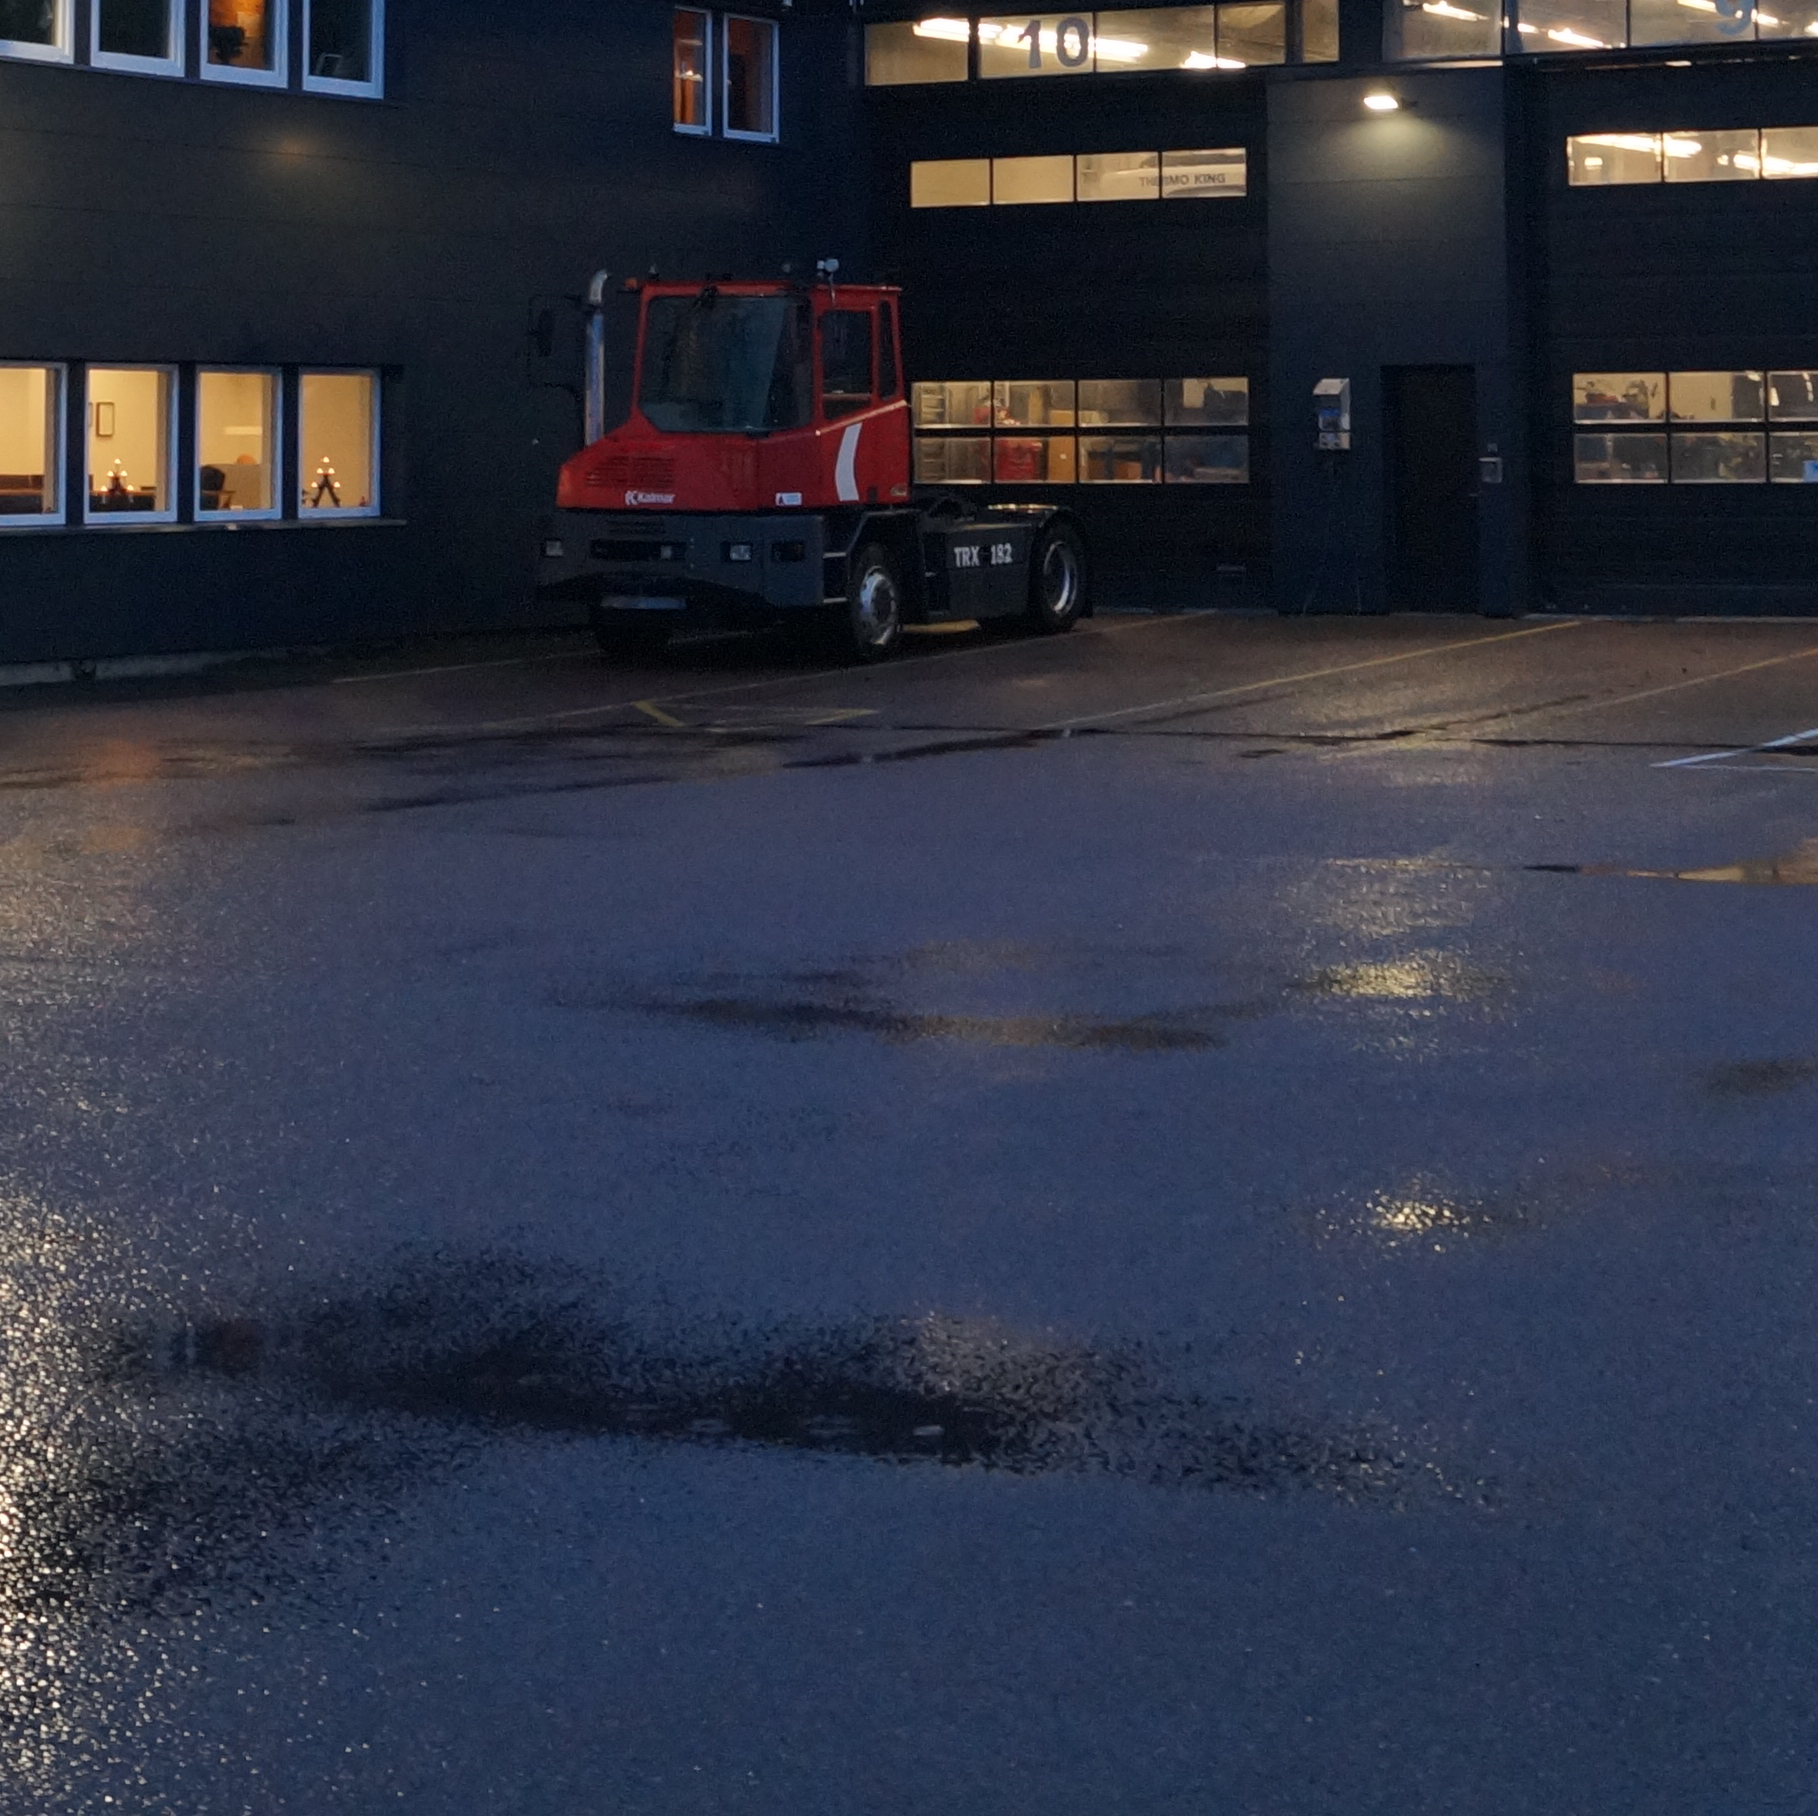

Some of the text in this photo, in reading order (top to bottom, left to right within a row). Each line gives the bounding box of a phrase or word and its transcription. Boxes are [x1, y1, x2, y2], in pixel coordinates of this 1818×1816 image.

[1017, 16, 1090, 69] 10
[1194, 173, 1226, 185] KING
[953, 542, 1013, 568] TRX 182
